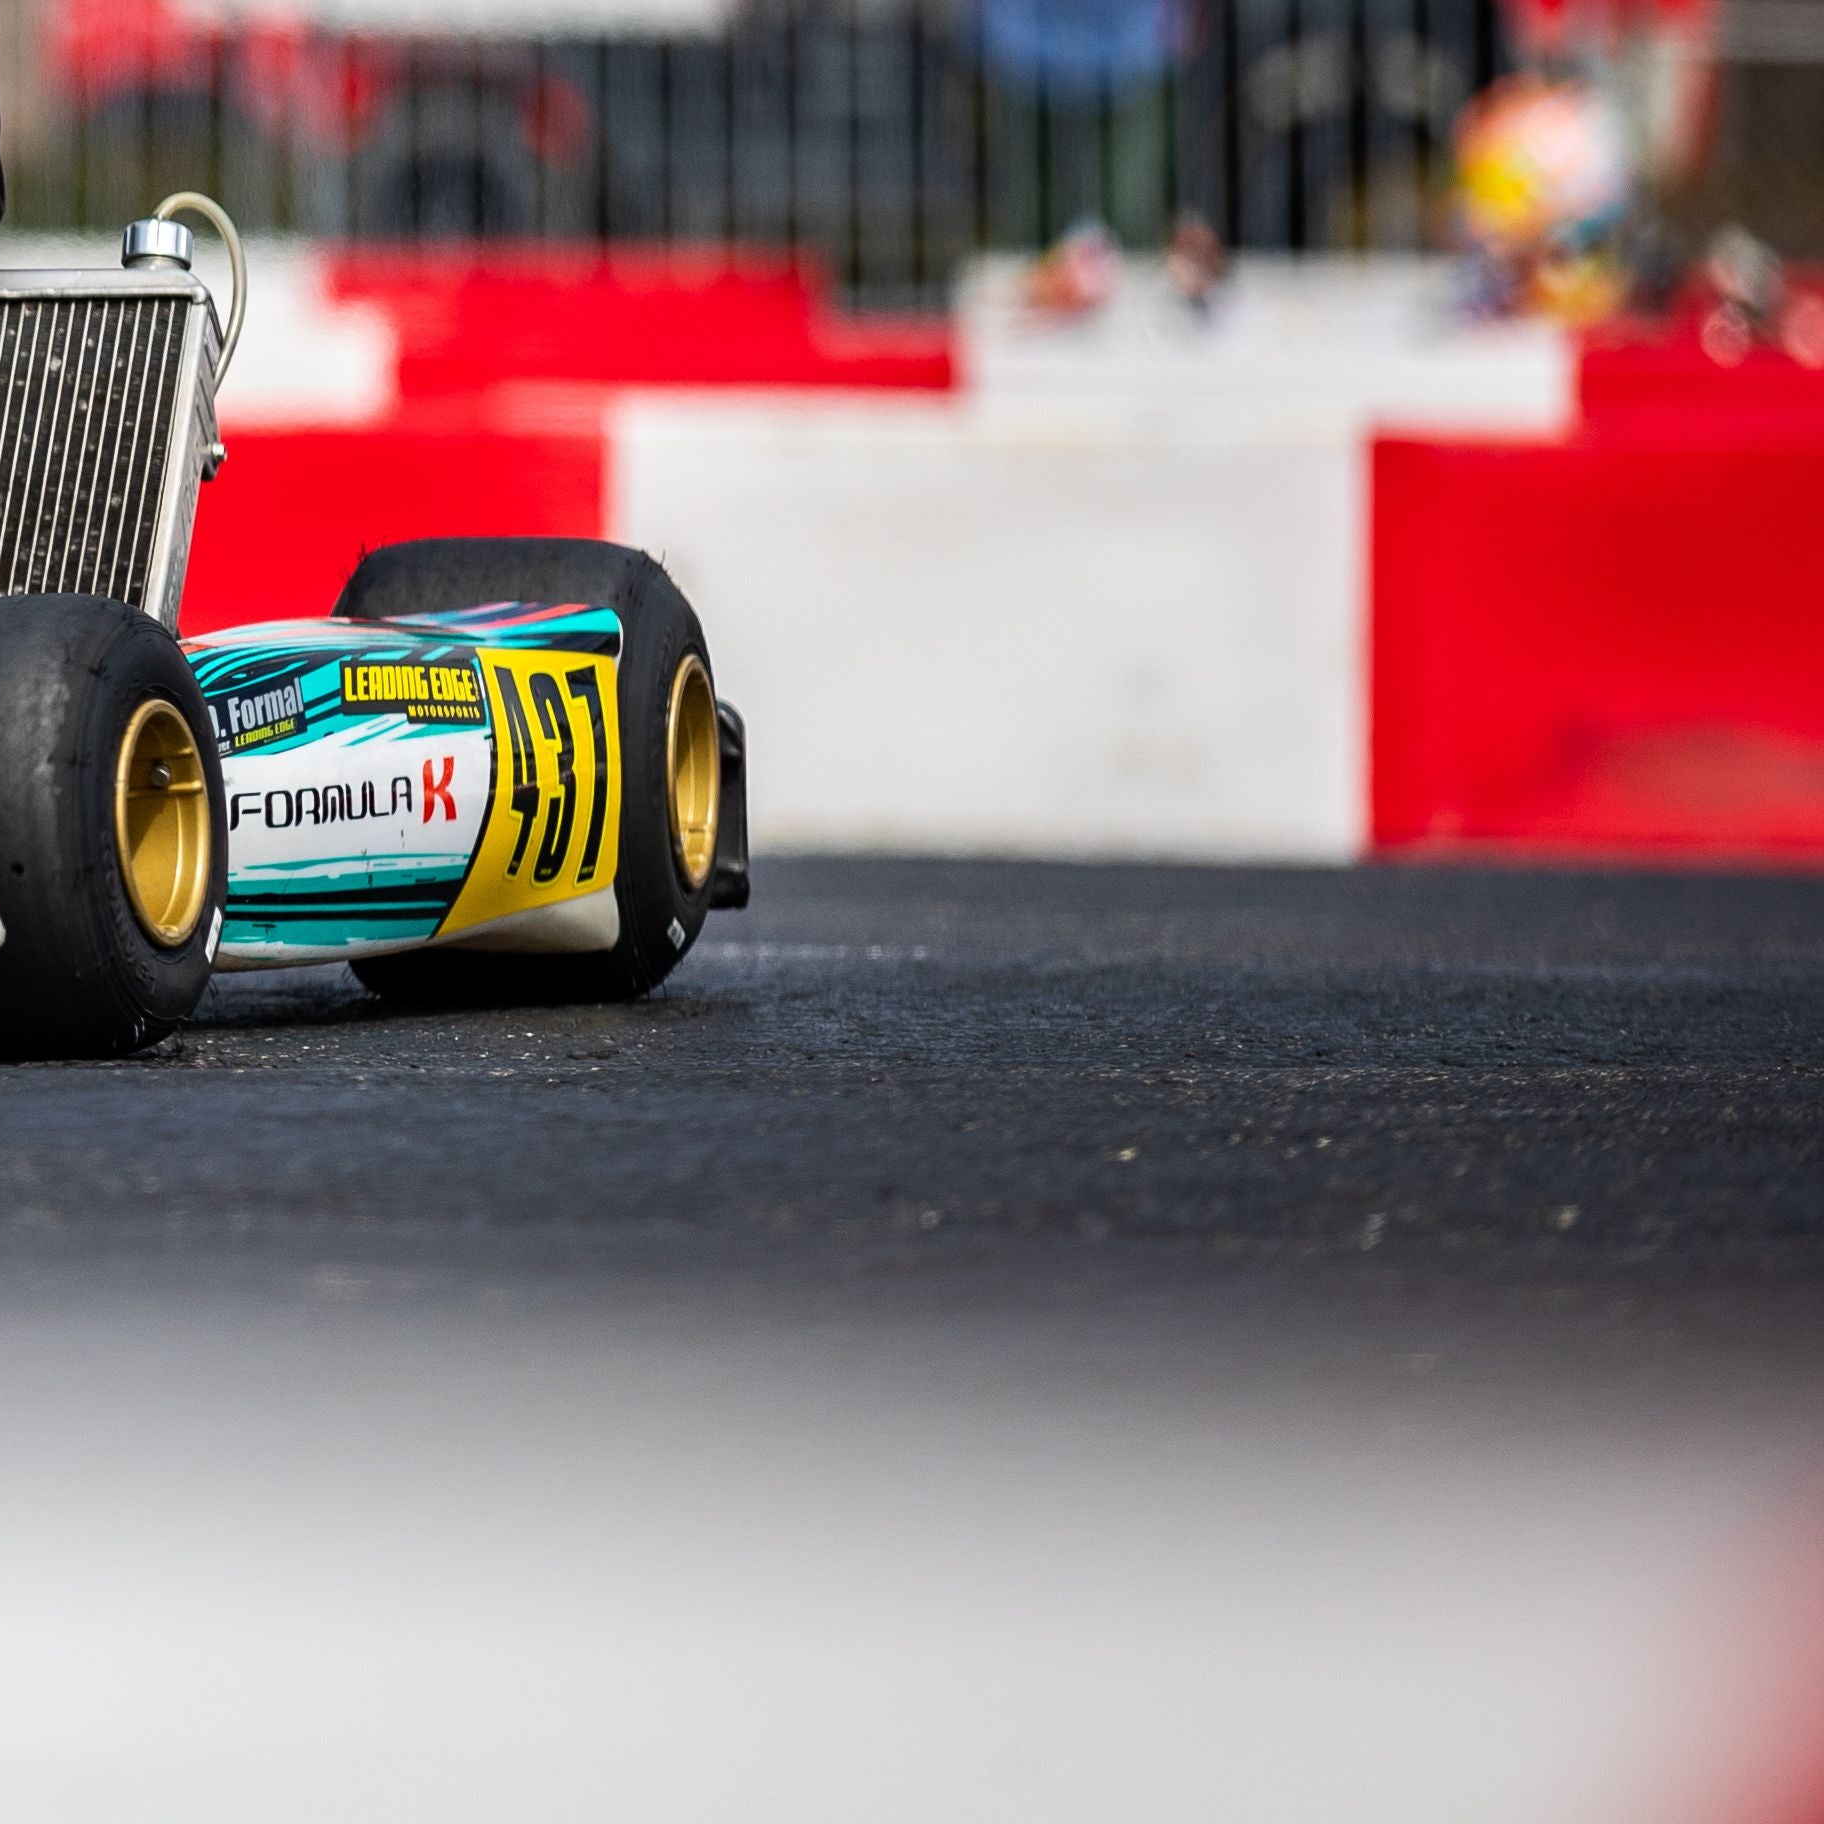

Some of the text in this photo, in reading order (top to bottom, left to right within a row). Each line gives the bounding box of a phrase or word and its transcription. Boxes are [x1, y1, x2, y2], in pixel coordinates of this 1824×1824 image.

[228, 676, 304, 734] Formal
[343, 665, 429, 701] LEADING
[430, 667, 476, 702] EDGE
[229, 756, 457, 831] FORMULA K
[493, 663, 609, 884] 437
